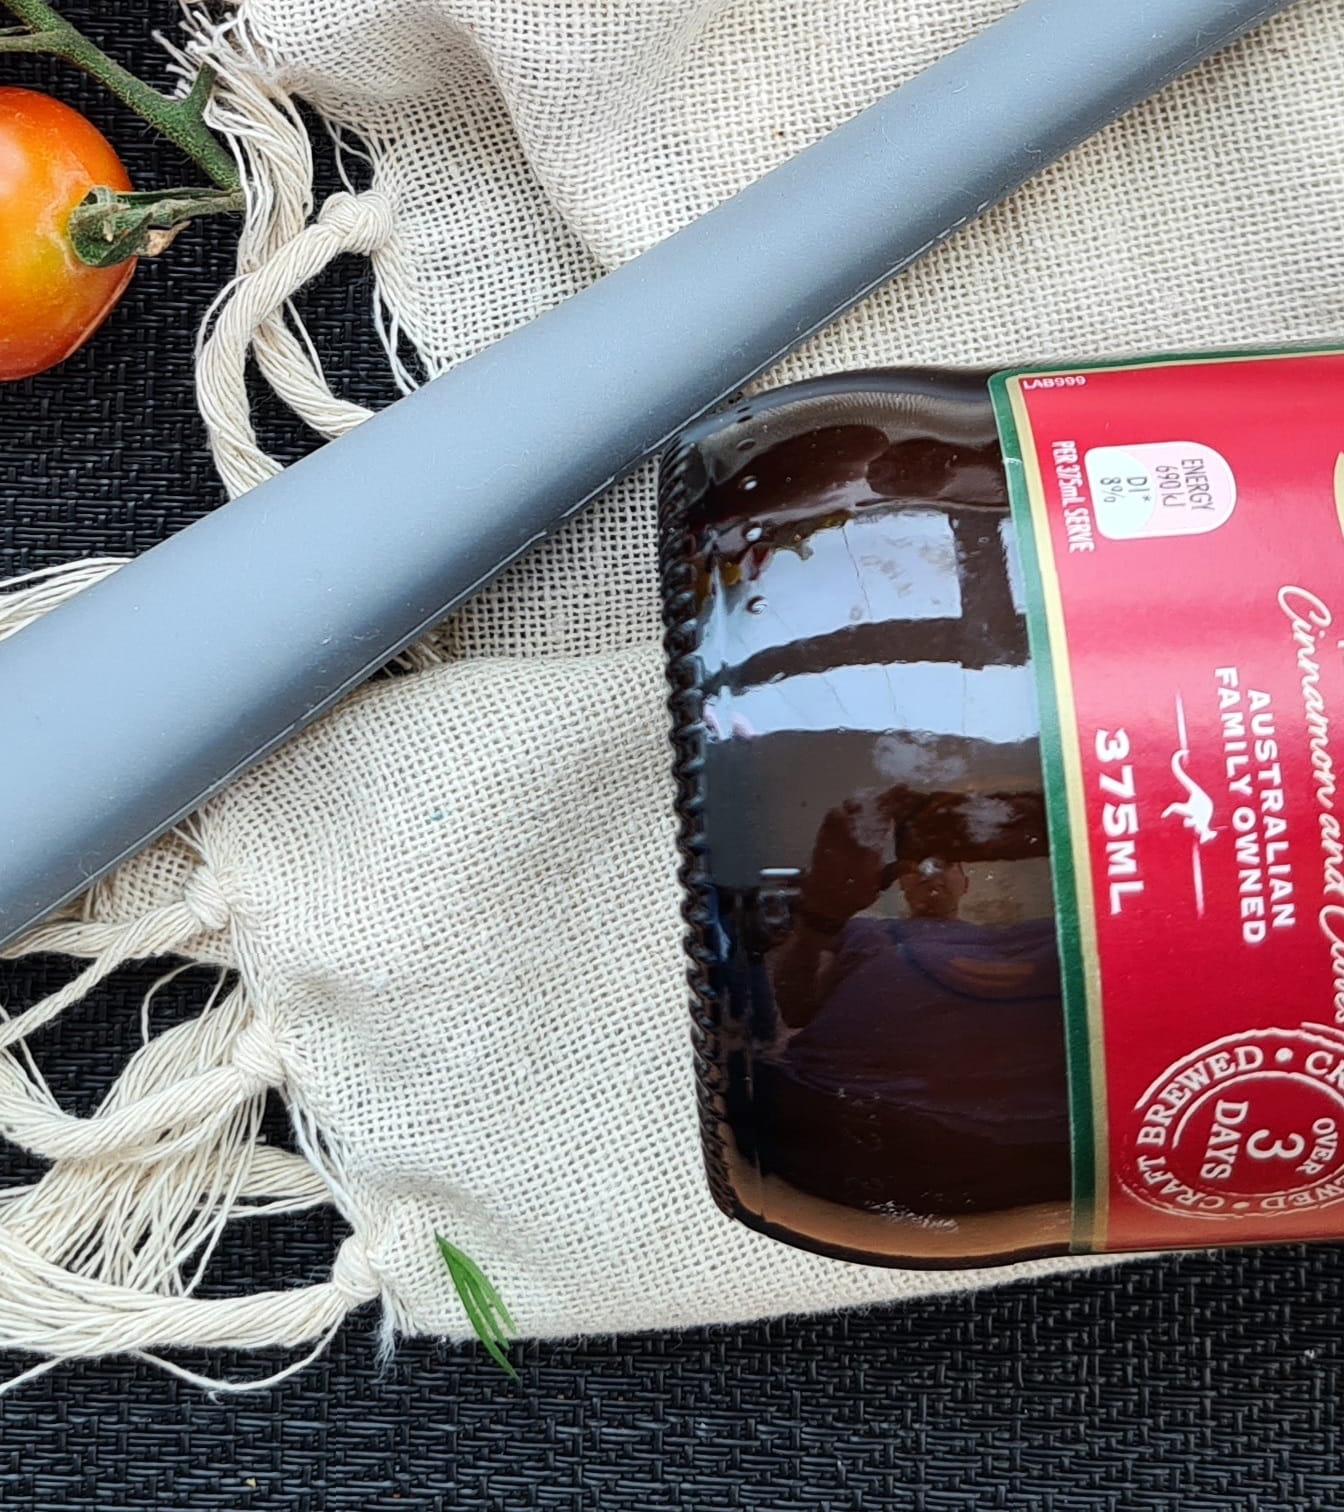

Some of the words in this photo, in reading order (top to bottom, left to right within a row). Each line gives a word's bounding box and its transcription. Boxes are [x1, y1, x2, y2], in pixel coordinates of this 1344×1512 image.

[1022, 376, 1086, 390] LAB999
[1051, 440, 1079, 464] PER
[1155, 464, 1182, 490] 690
[1056, 464, 1087, 507] 375mL
[1099, 476, 1125, 504] 8%
[1161, 492, 1186, 508] kJ
[1181, 458, 1215, 511] ENERGY
[1064, 507, 1095, 553] SERVE
[1277, 585, 1336, 809] Cinnamon
[1214, 666, 1253, 797] FAMILY
[1094, 728, 1145, 916] 375ML
[1246, 690, 1296, 928] AUSTRALIAN
[1231, 808, 1267, 944] OWNED
[1136, 1044, 1265, 1147] BREWED
[1200, 1099, 1250, 1180] DAYS
[1245, 1129, 1305, 1160] 3
[1295, 1117, 1339, 1175] OVER
[1136, 1155, 1225, 1210] CRAFT
